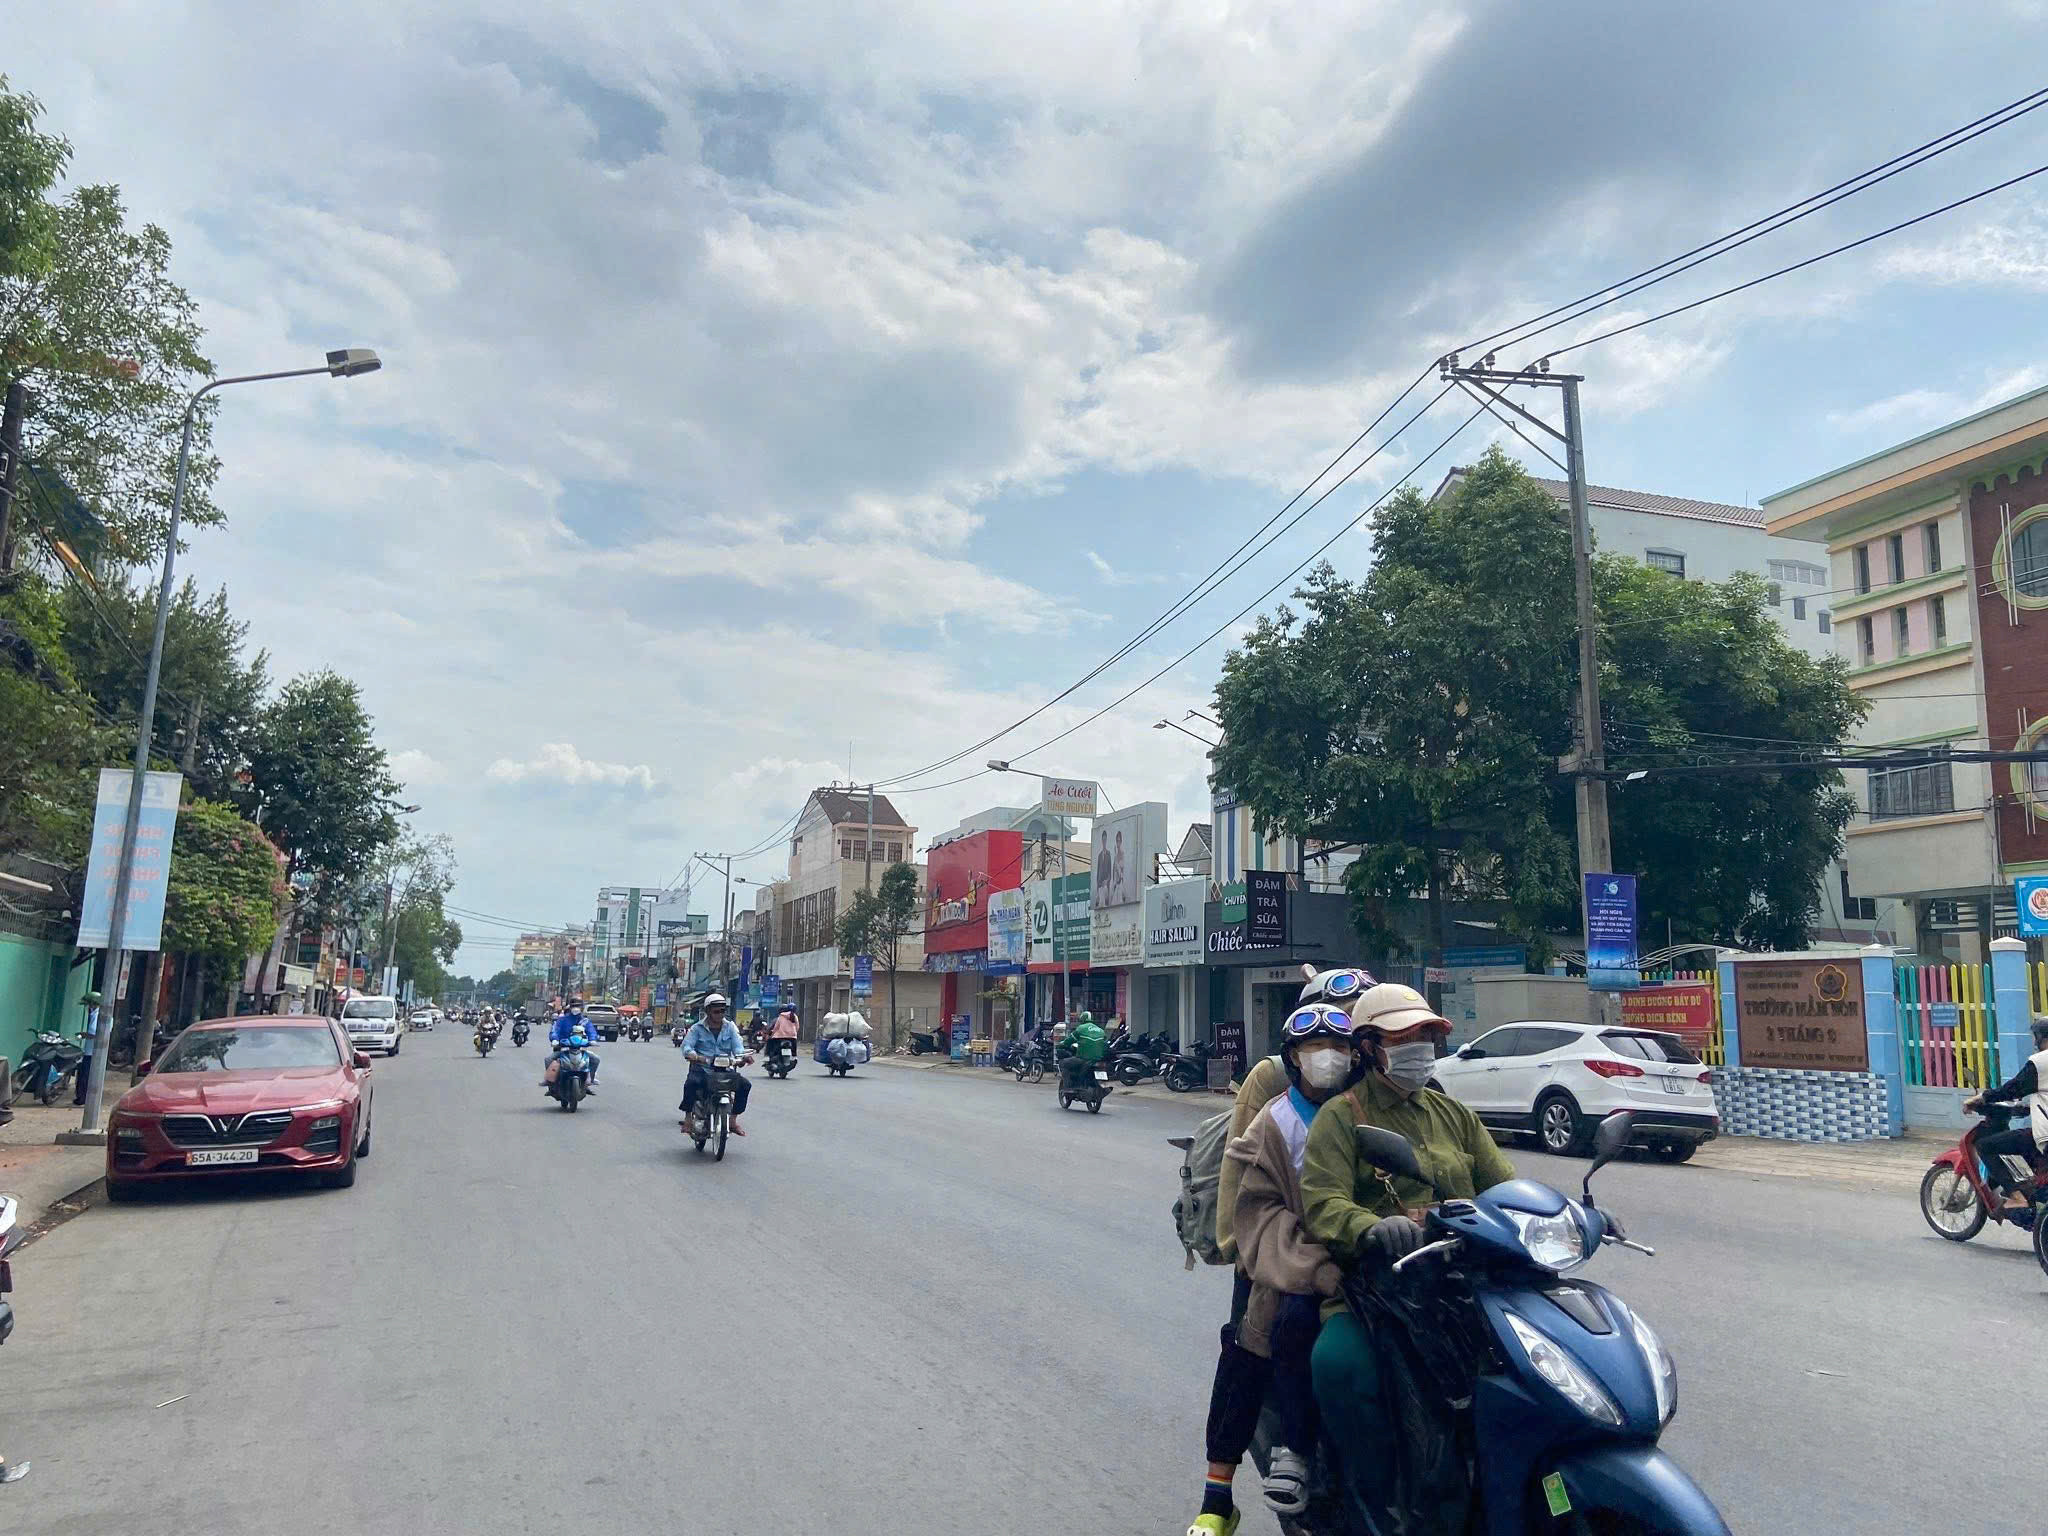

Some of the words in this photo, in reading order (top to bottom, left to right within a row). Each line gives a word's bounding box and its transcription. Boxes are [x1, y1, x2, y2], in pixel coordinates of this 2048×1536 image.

[1256, 896, 1278, 907] TRÀ
[1256, 912, 1278, 925] SỮA
[1150, 928, 1167, 945] HAIR
[1168, 925, 1196, 942] SALON
[1208, 926, 1243, 952] Chiếc
